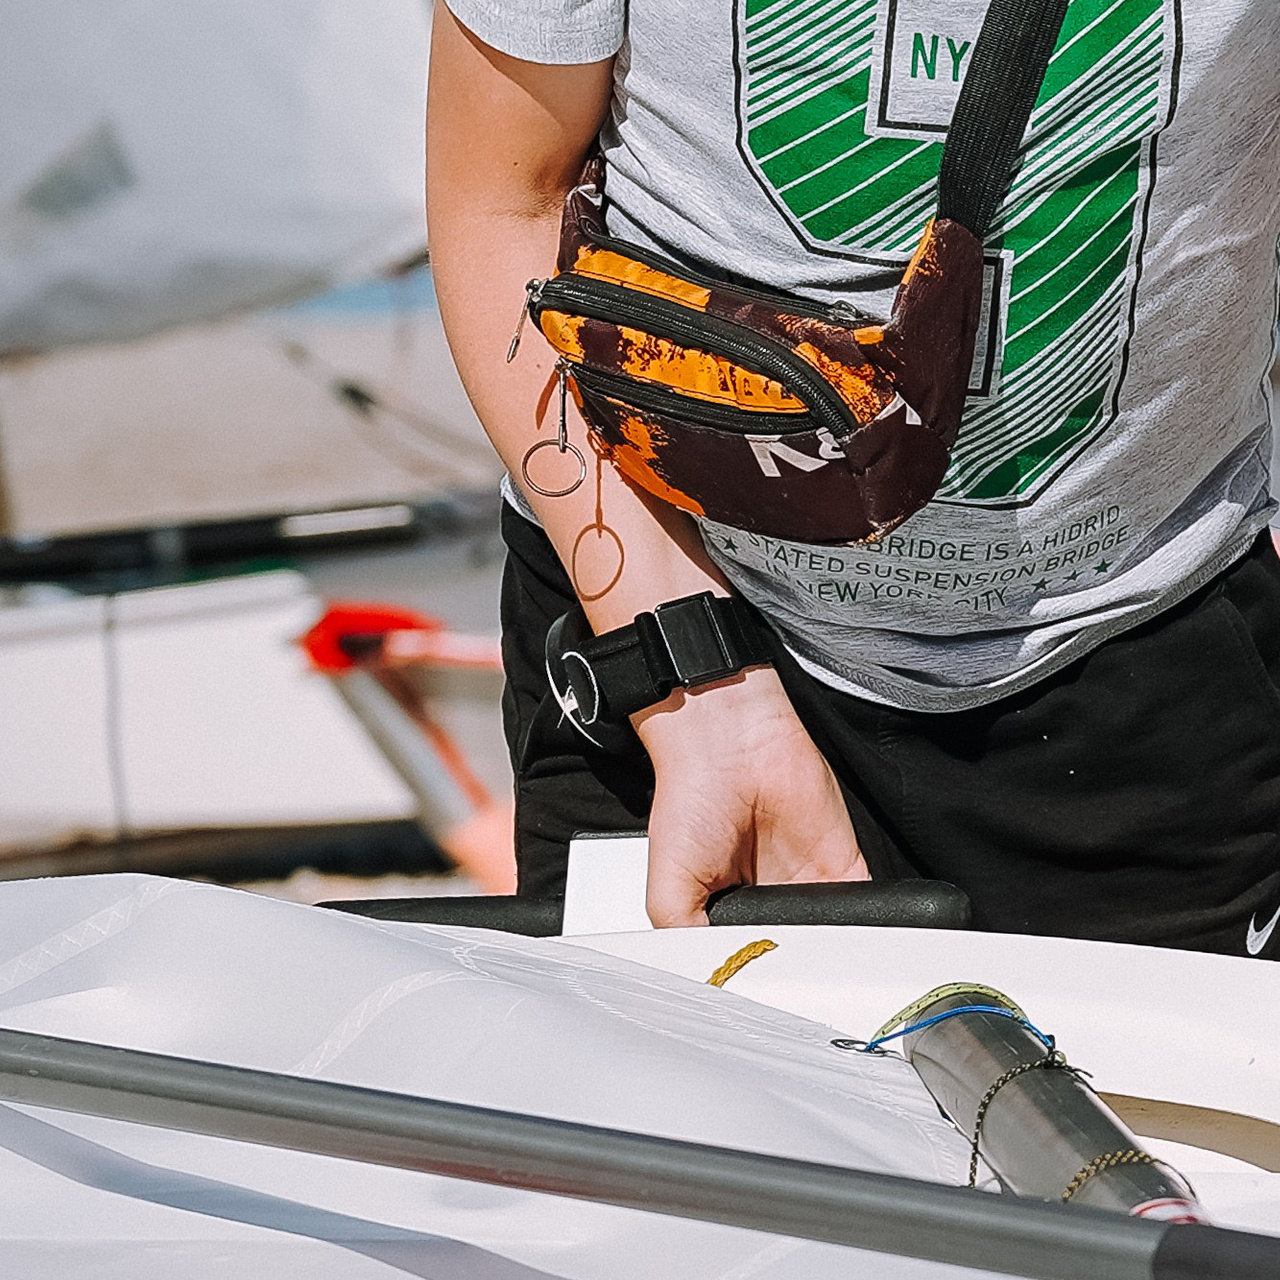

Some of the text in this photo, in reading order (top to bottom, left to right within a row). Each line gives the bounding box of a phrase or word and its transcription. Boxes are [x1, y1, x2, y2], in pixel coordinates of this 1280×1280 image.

[910, 32, 972, 82] NY
[855, 561, 1036, 590] SUSPENSION
[1044, 524, 1130, 572] BRIDGE
[985, 543, 1009, 561] IS
[1017, 540, 1034, 557] A
[1042, 505, 1120, 551] HIDRID
